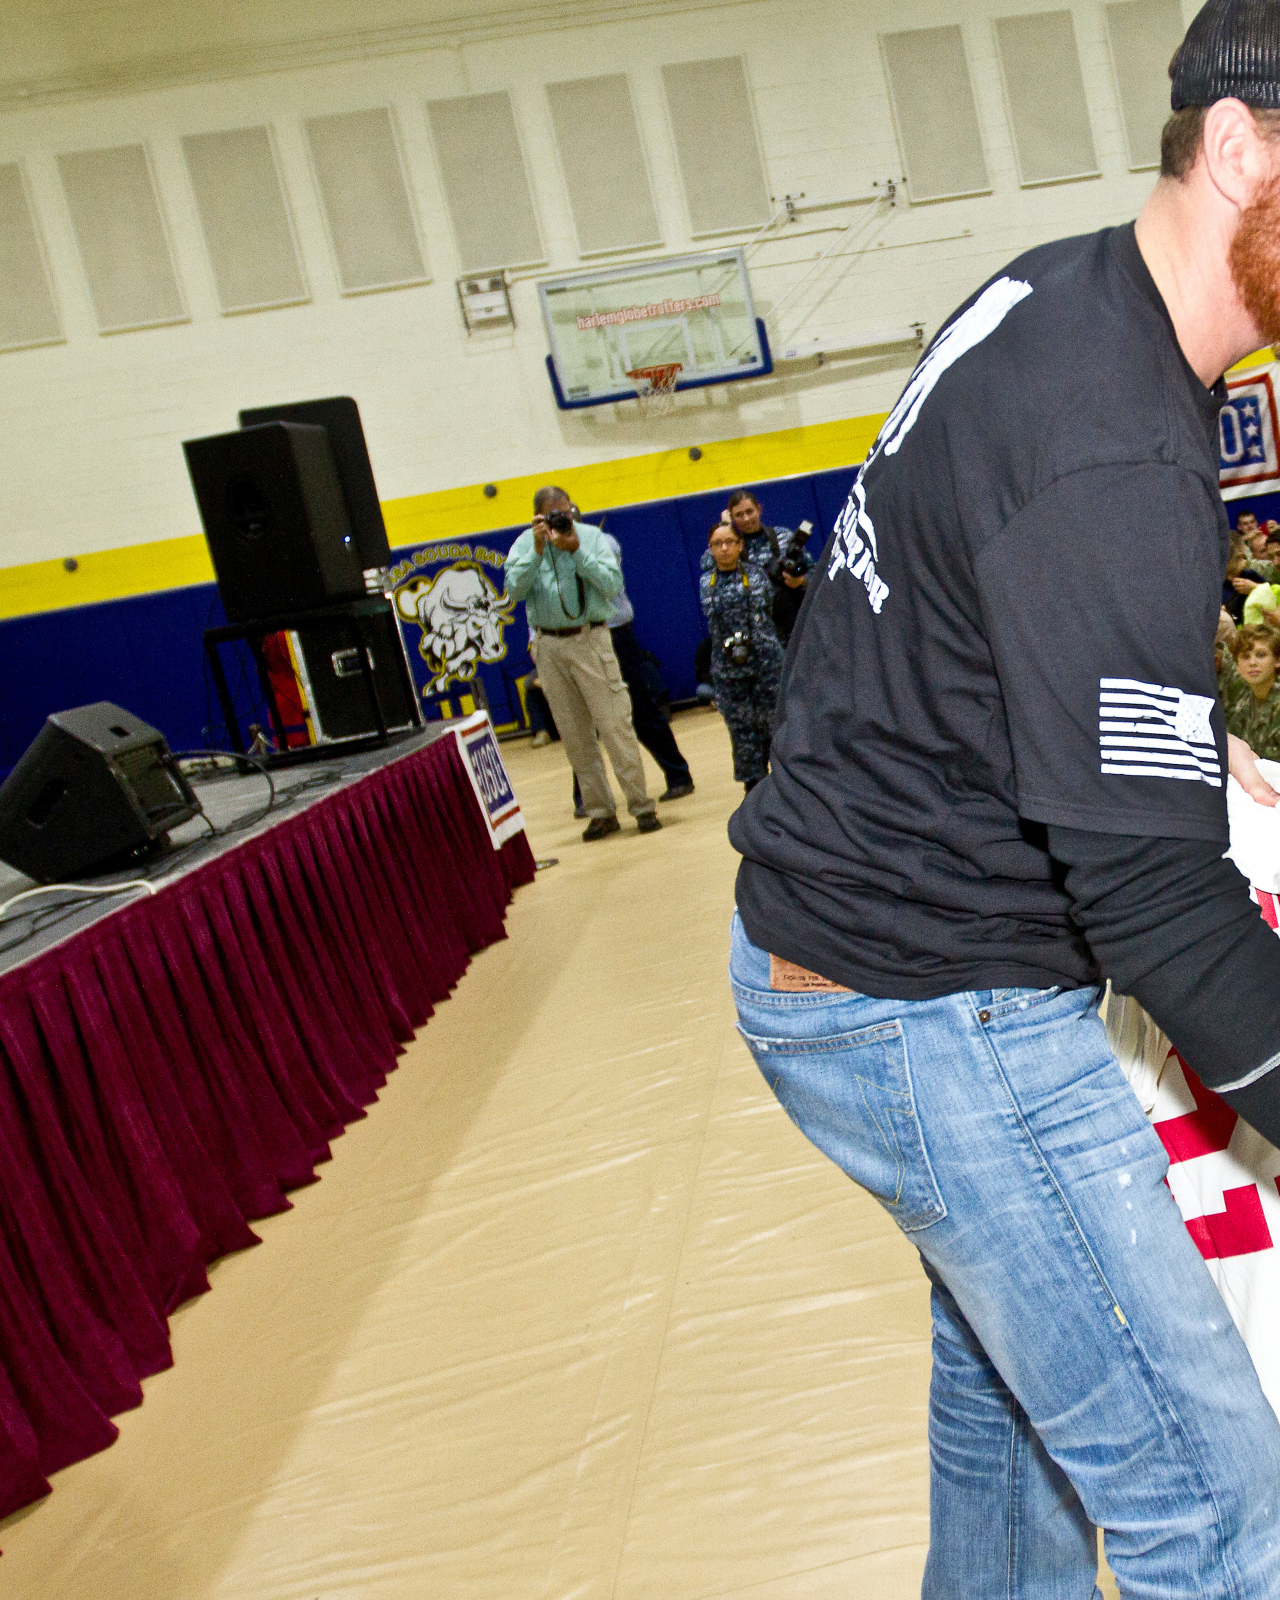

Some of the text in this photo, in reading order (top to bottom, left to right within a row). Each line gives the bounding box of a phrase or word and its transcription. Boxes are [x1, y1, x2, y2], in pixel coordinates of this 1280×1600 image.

[576, 293, 721, 330] harlemglobetrotters.com
[390, 545, 507, 584] SA SOUDA BAY
